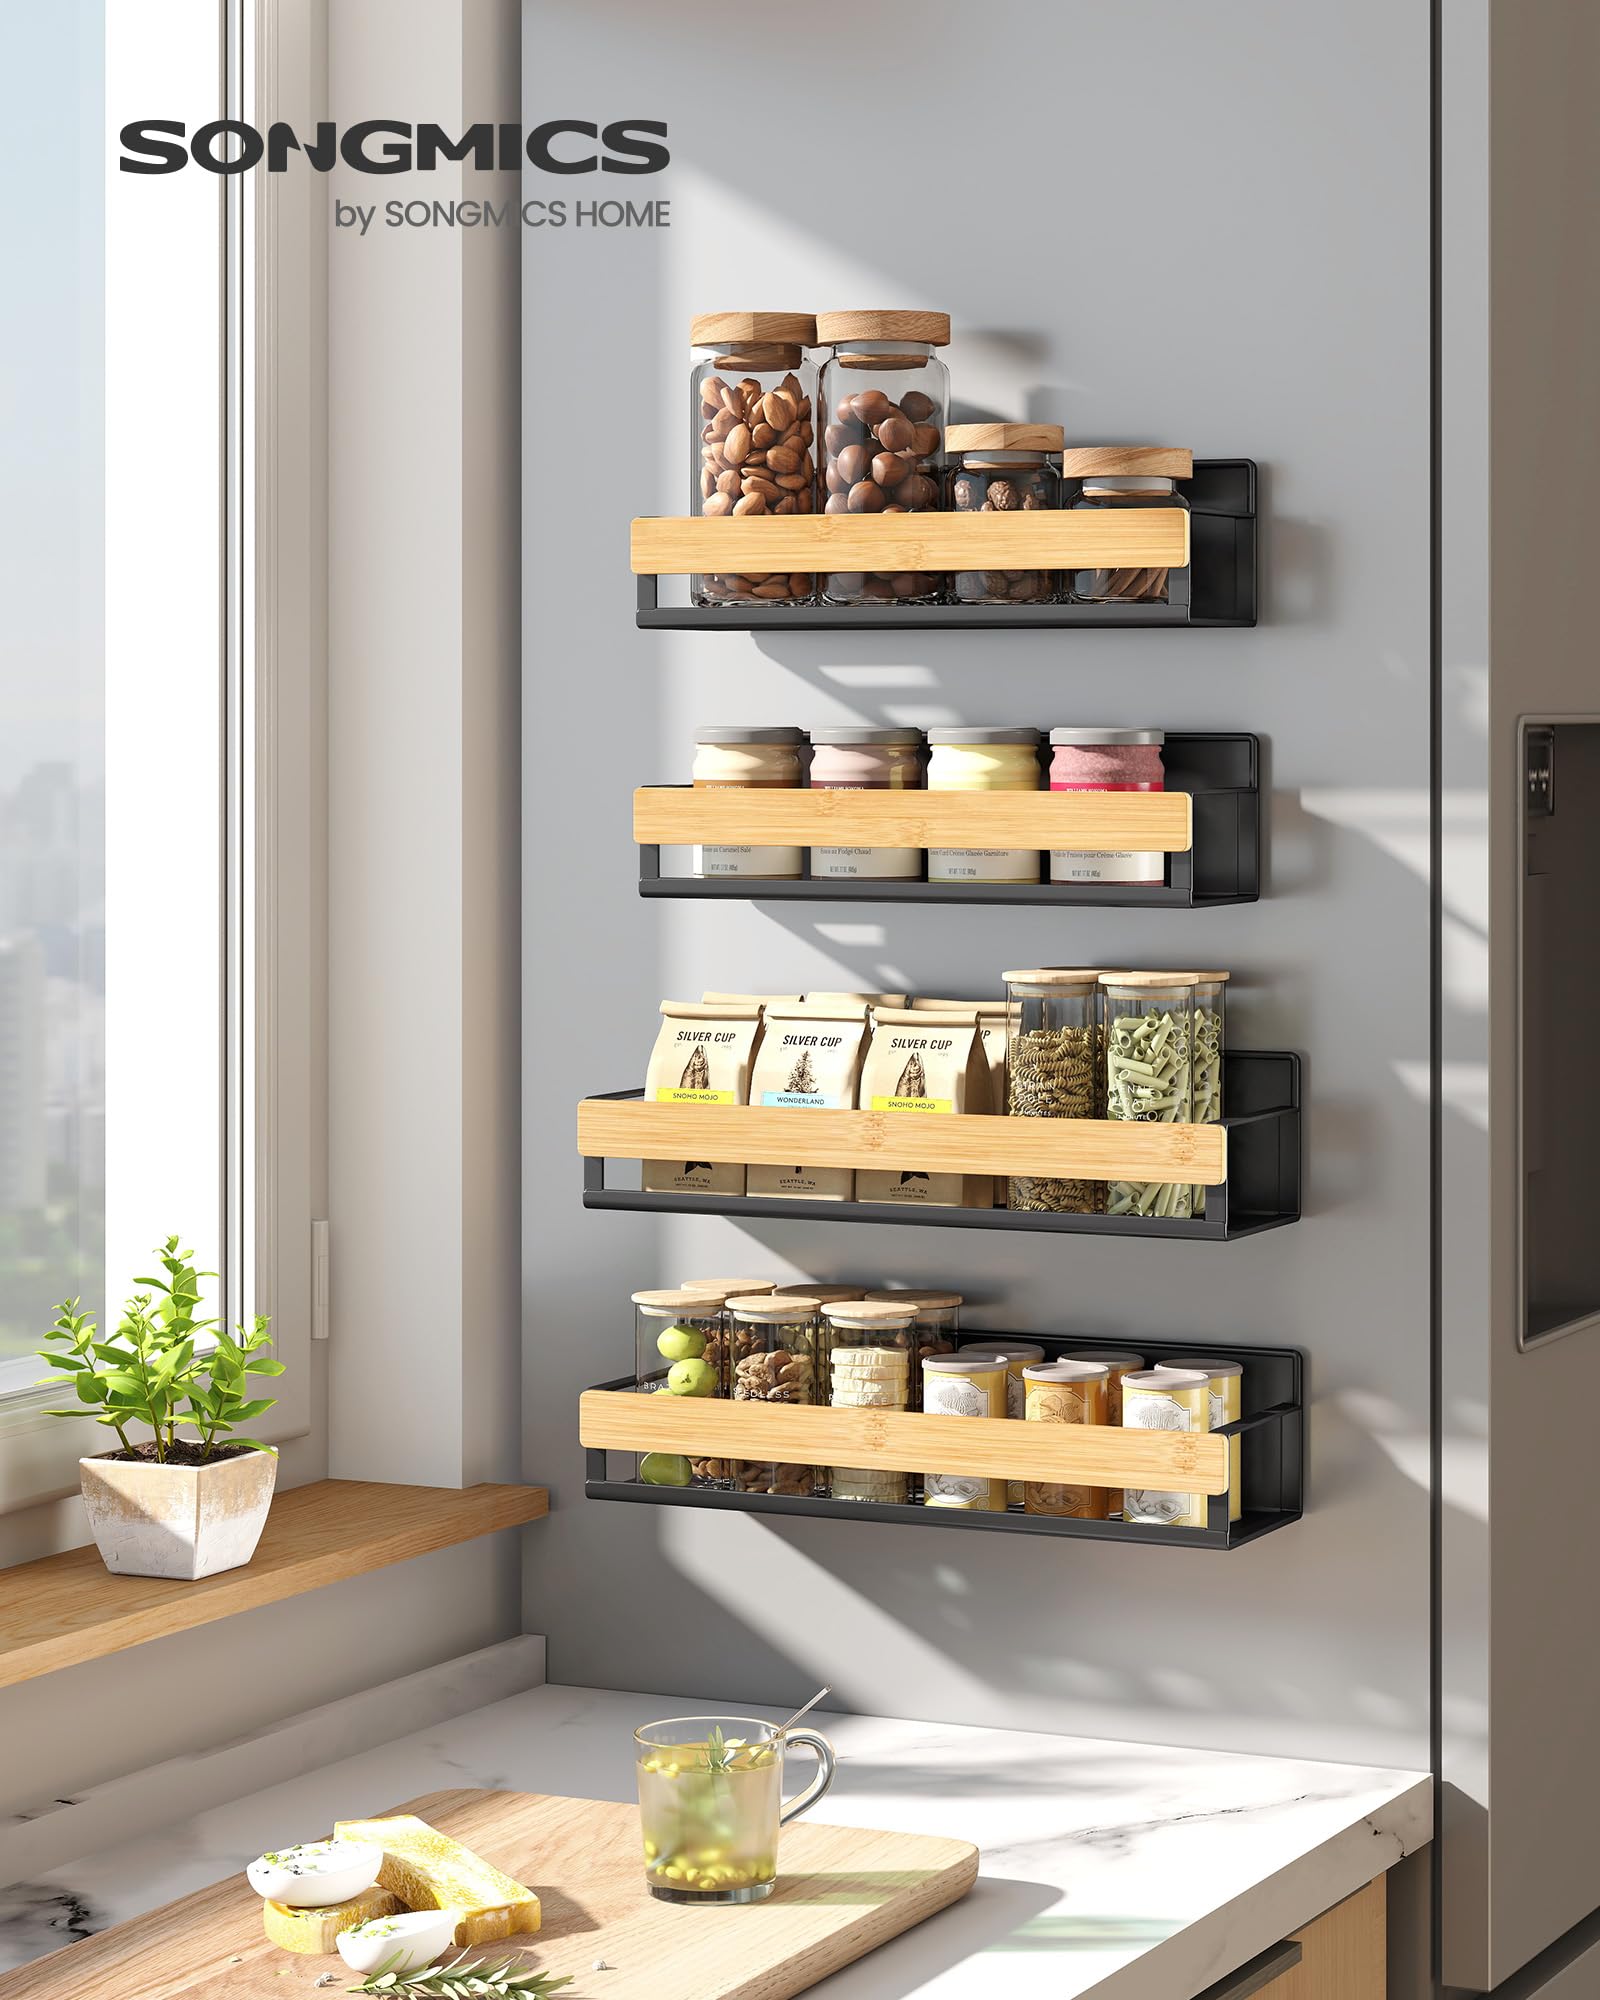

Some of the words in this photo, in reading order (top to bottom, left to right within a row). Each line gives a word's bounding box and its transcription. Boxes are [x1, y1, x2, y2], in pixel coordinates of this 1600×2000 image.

[676, 1030, 712, 1042] SILVER
[714, 1032, 737, 1043] CUP
[782, 1034, 819, 1047] SILVER
[819, 1036, 843, 1048] CUP
[890, 1038, 928, 1049] SILVER
[929, 1039, 953, 1051] CUP
[672, 1092, 698, 1100] SNOHO
[776, 1096, 825, 1106] WONDERLAND
[887, 1101, 914, 1109] SNOHO
[914, 1102, 936, 1110] MOJO
